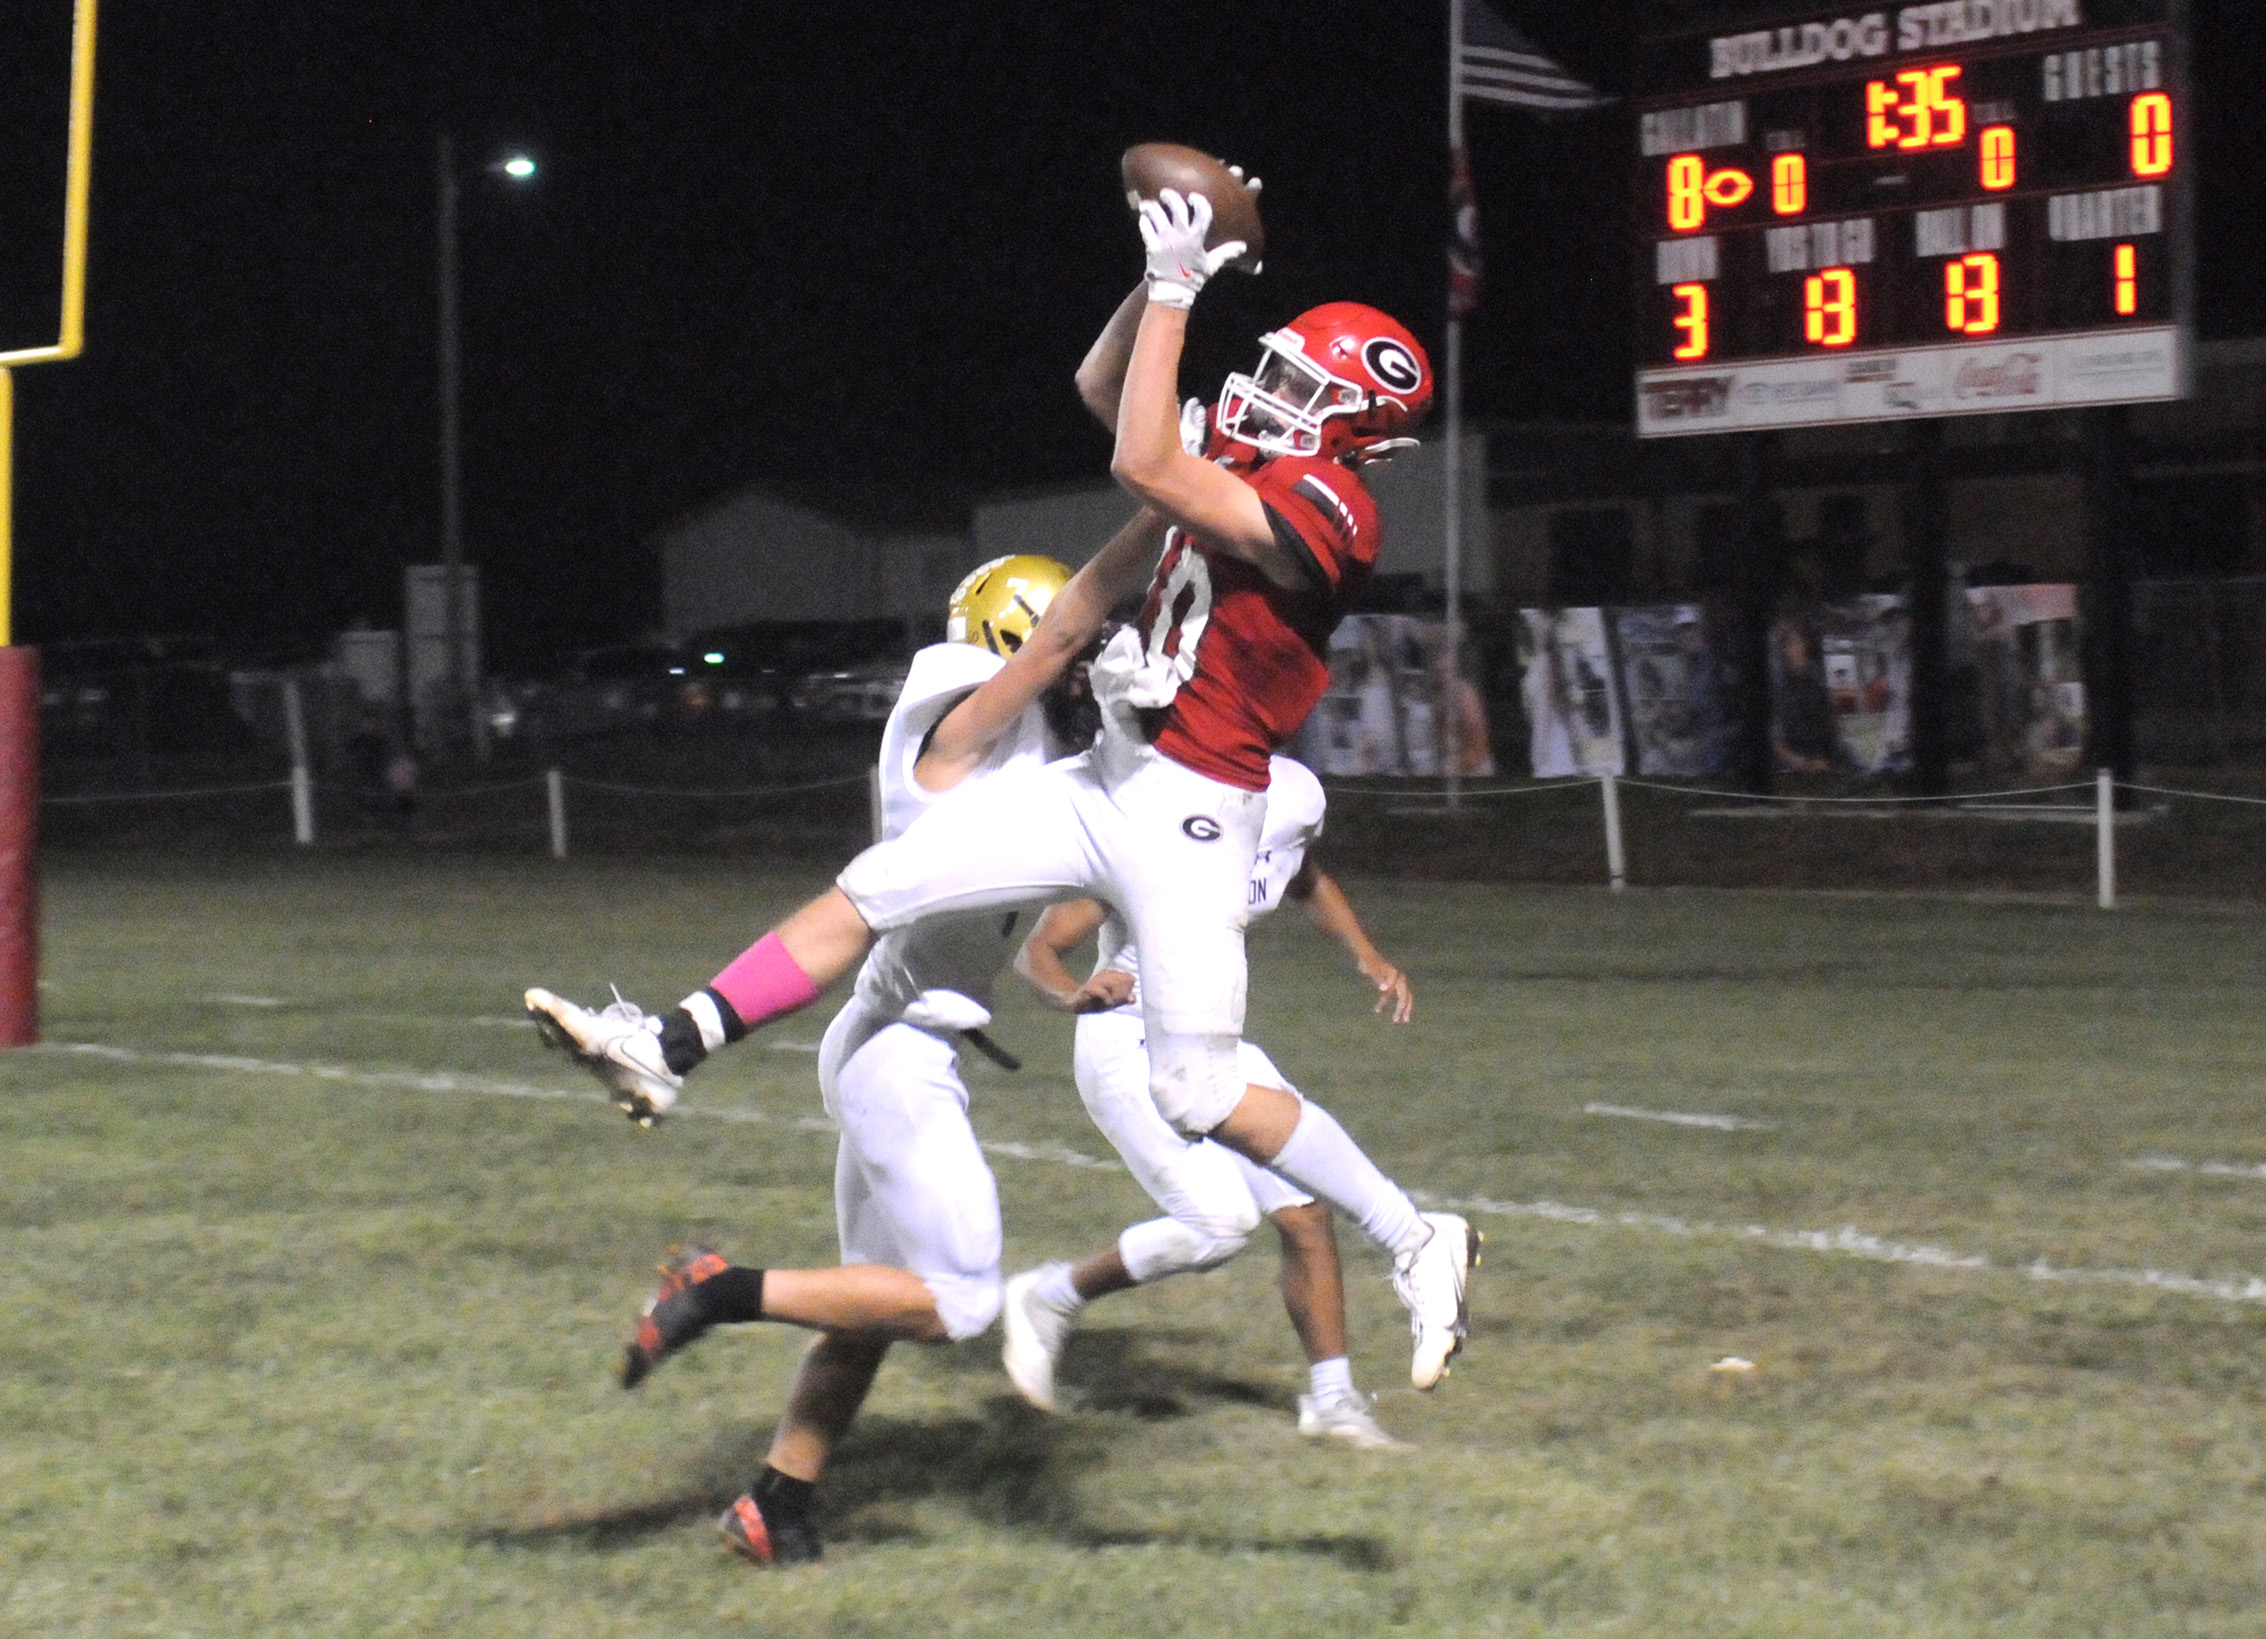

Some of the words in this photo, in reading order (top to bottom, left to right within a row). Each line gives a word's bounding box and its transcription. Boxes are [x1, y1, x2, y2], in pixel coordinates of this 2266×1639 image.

[1710, 13, 1888, 79] BULLDOG
[1898, 0, 2081, 50] STADIUM
[1866, 65, 1967, 150] 1:35
[2130, 92, 2173, 179] 0
[1667, 154, 1705, 232] 8
[1772, 153, 1807, 215] 0
[1979, 126, 2015, 190] 0
[1805, 267, 1857, 347] 13
[1945, 252, 2000, 334] 13
[2115, 245, 2136, 315] 1
[1673, 282, 1709, 360] 3
[1362, 337, 1421, 394] G
[1181, 815, 1222, 842] G
